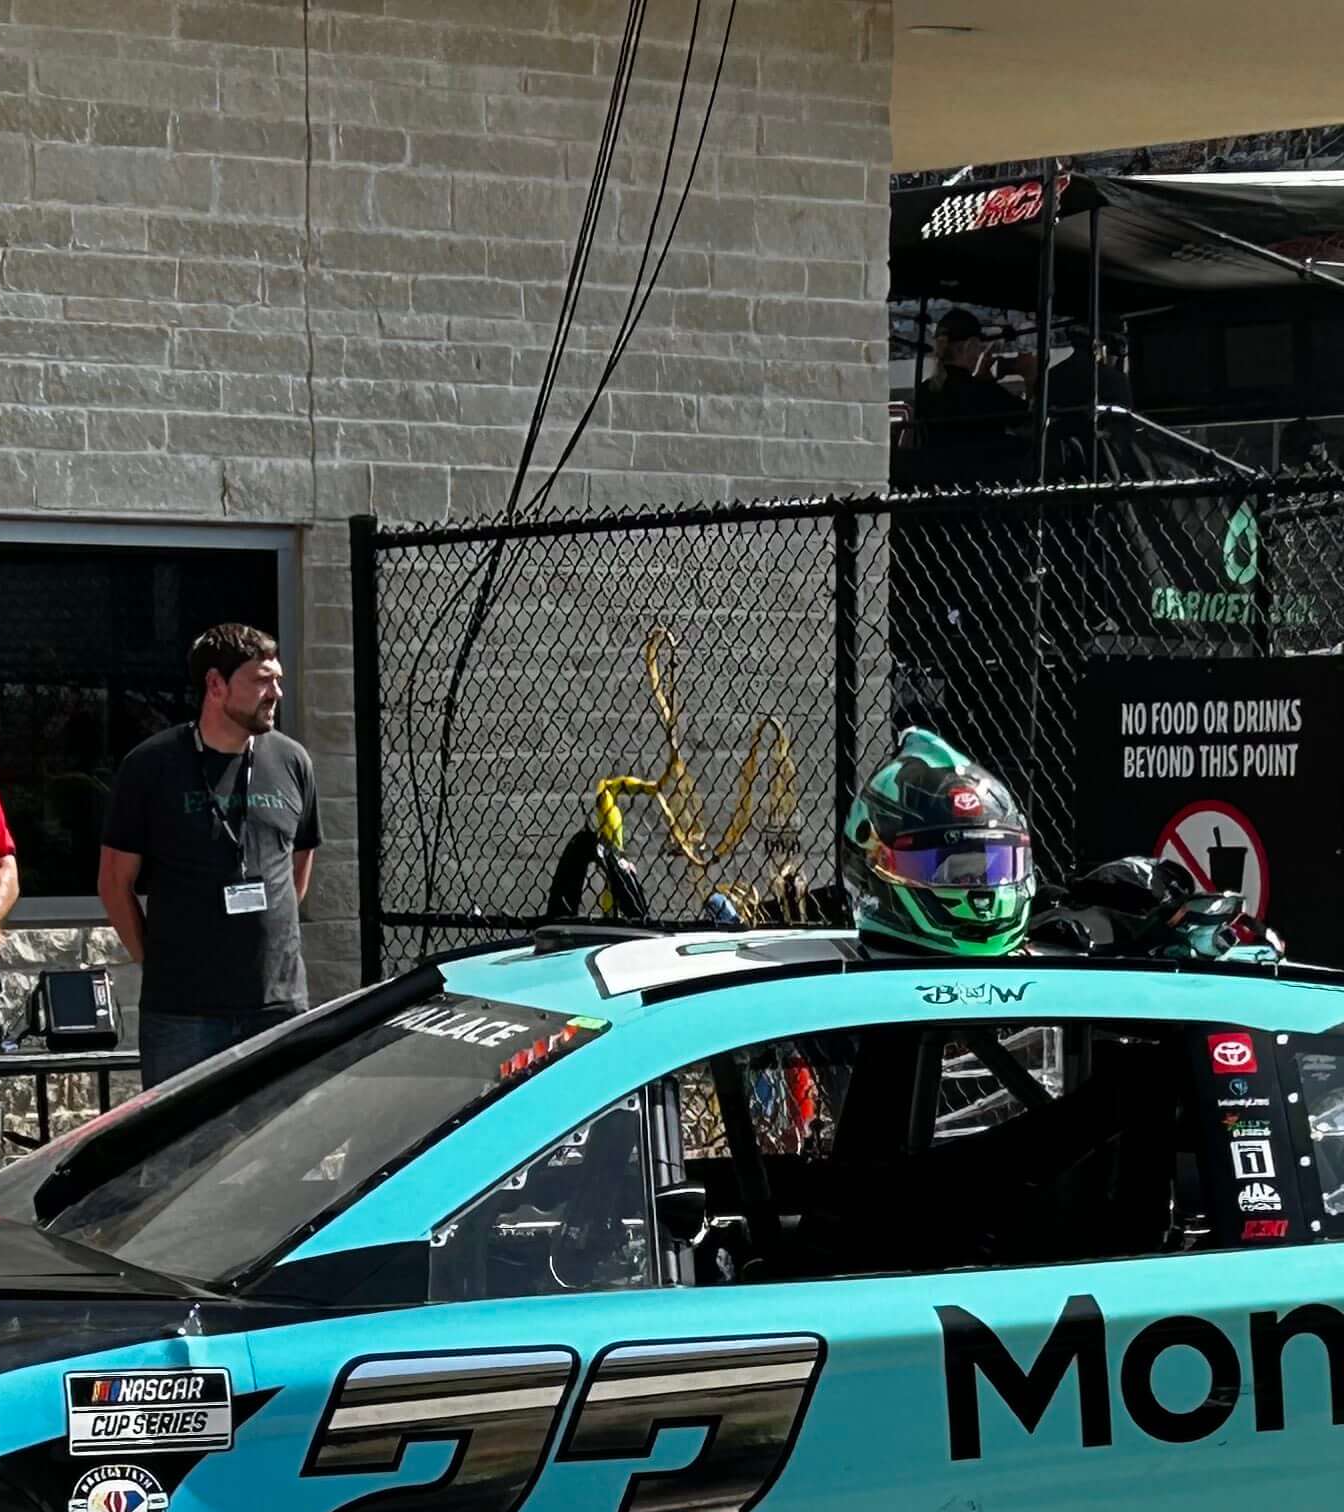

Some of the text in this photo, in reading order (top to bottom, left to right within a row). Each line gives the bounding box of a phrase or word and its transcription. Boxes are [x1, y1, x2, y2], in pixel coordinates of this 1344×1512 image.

[1121, 698, 1302, 735] NO FOOD OR DRINKS
[1123, 744, 1298, 778] BEYOND THIS POINT
[117, 1377, 204, 1402] NASCAR
[91, 1411, 209, 1437] CUP SERIES
